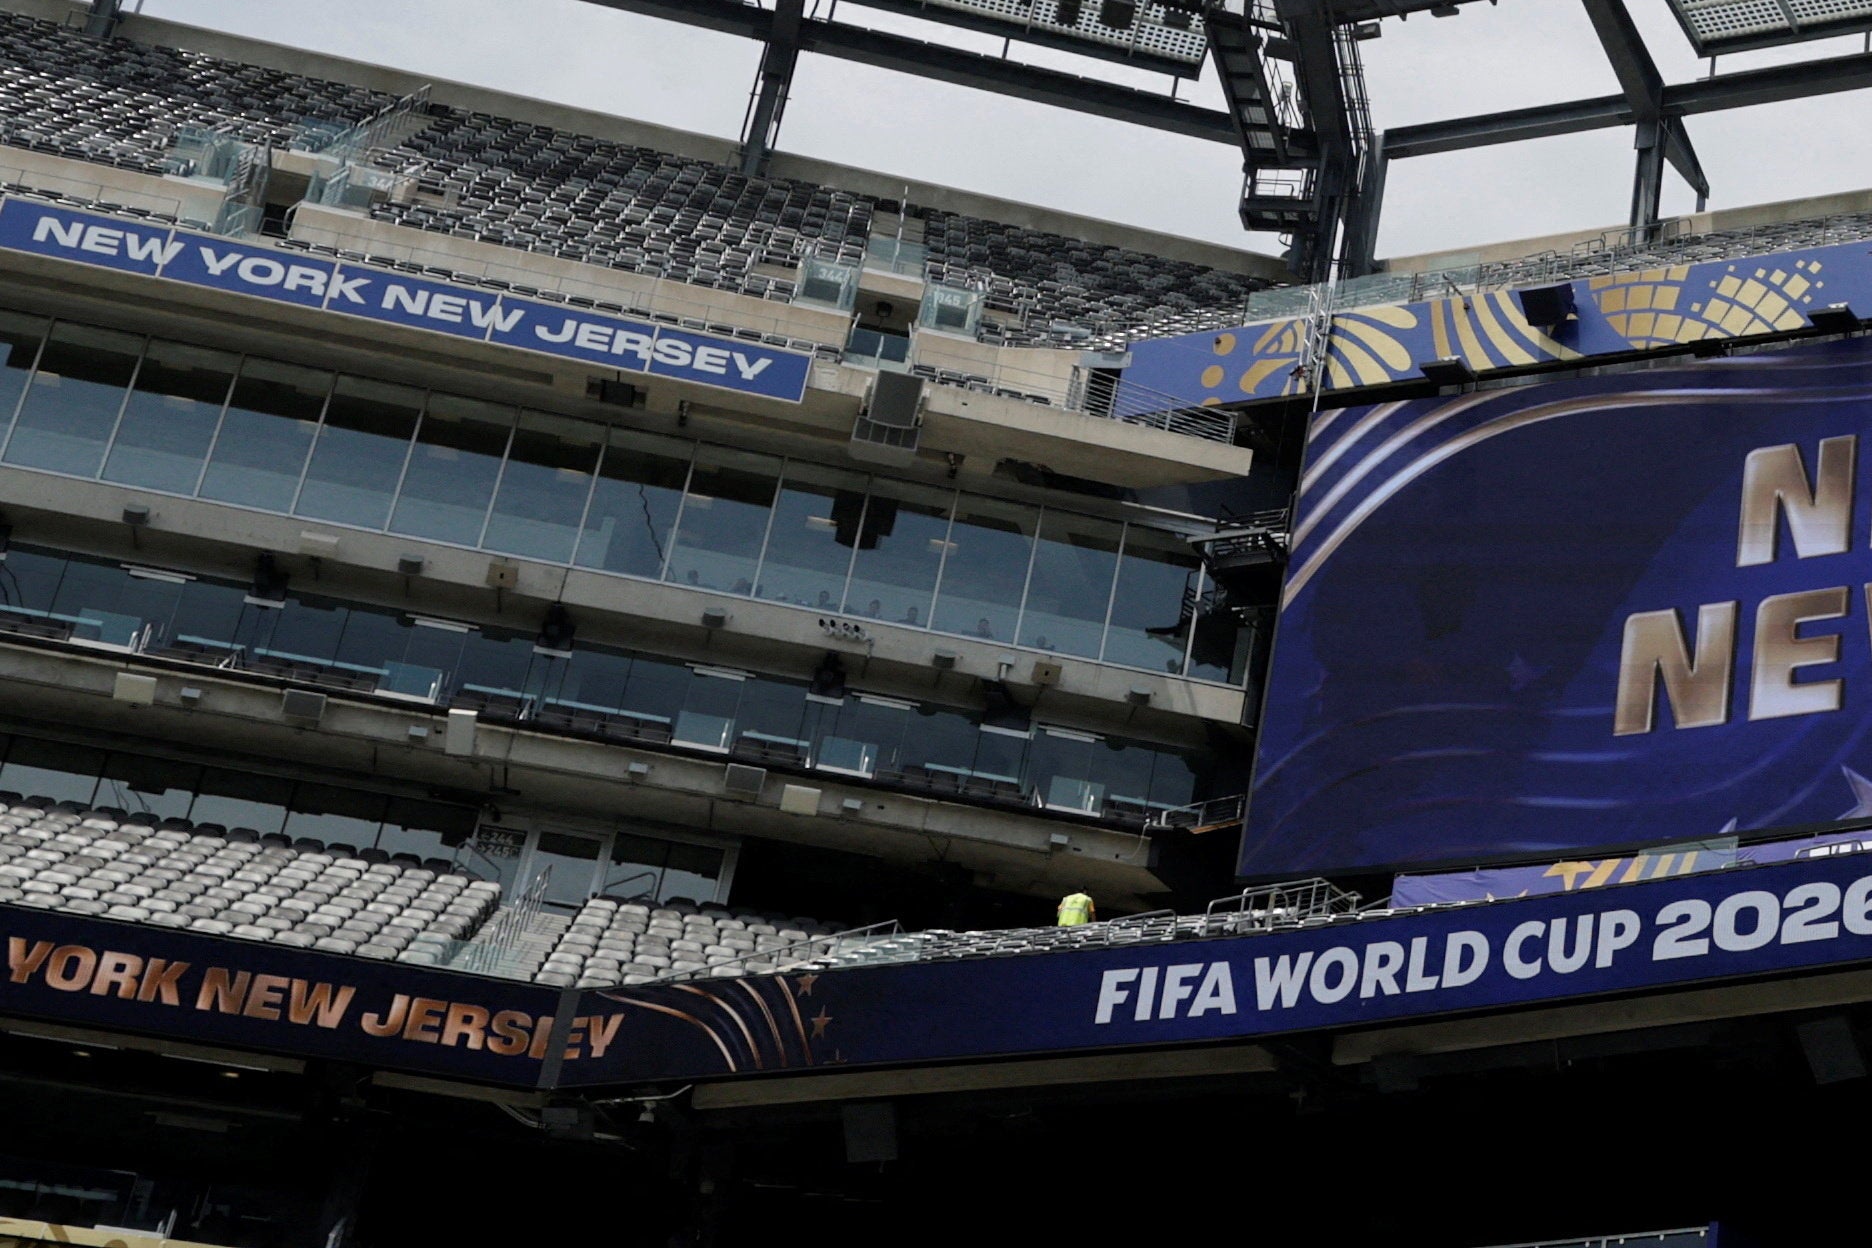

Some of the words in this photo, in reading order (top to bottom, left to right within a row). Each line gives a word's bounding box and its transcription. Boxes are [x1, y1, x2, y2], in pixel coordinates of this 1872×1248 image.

[33, 216, 185, 265] NEW
[199, 247, 372, 305] YORK
[381, 284, 525, 332] NEW
[535, 318, 772, 380] JERSEY
[9, 936, 191, 1006] YORK
[195, 967, 356, 1029] NEW
[361, 993, 625, 1060] JERSEY
[1094, 961, 1236, 1023] FIFA
[1254, 930, 1489, 1010] WORLD
[1503, 909, 1641, 980] CUP
